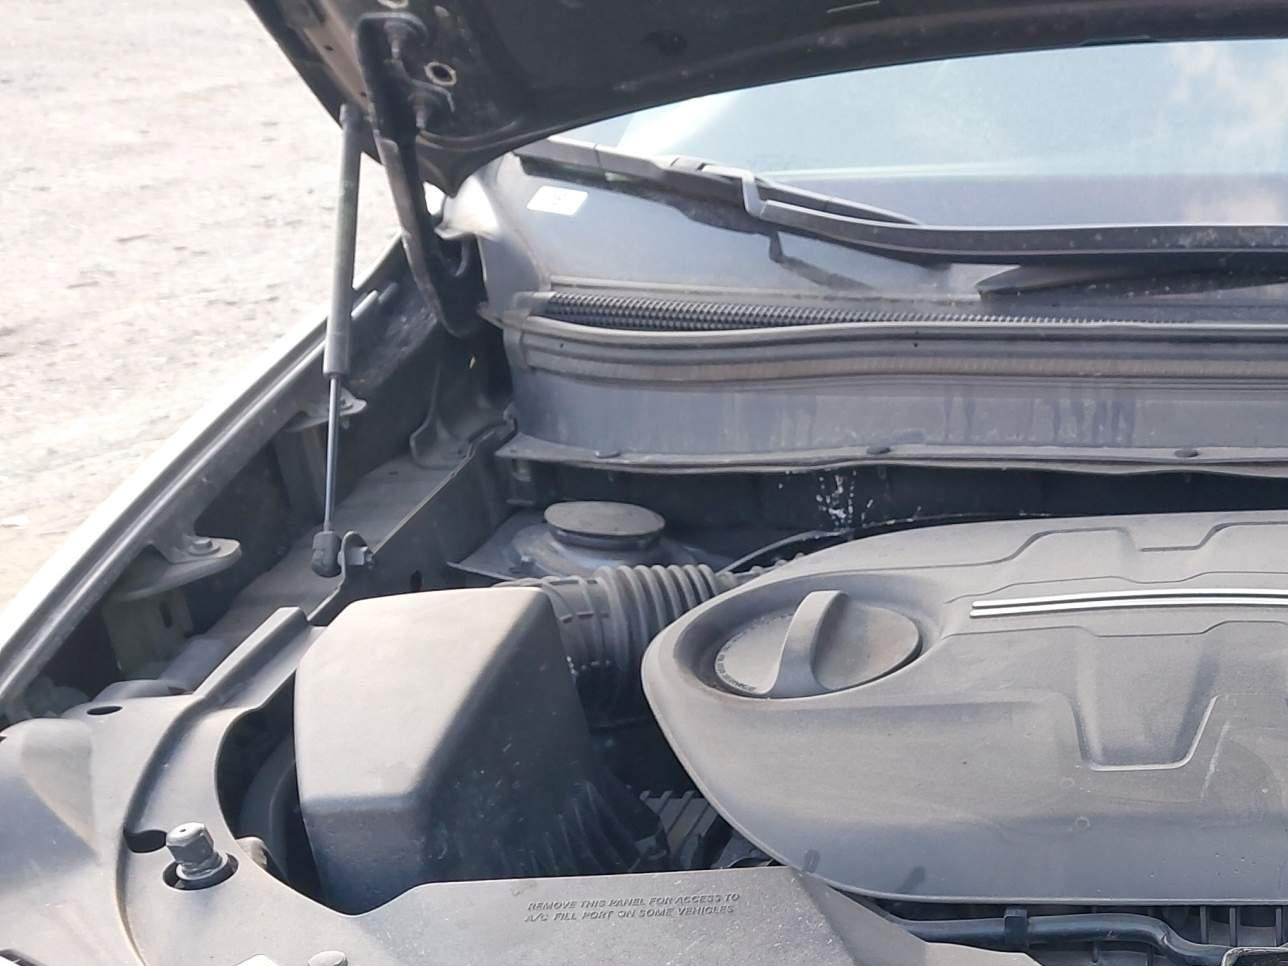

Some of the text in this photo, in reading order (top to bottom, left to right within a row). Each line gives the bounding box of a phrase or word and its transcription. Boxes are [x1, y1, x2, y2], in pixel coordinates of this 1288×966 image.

[528, 893, 741, 912] REMOVE THIS PANEL FOR ACCESS TO
[524, 905, 735, 923] A/C FILL PORT ON SOME VEHICLES
